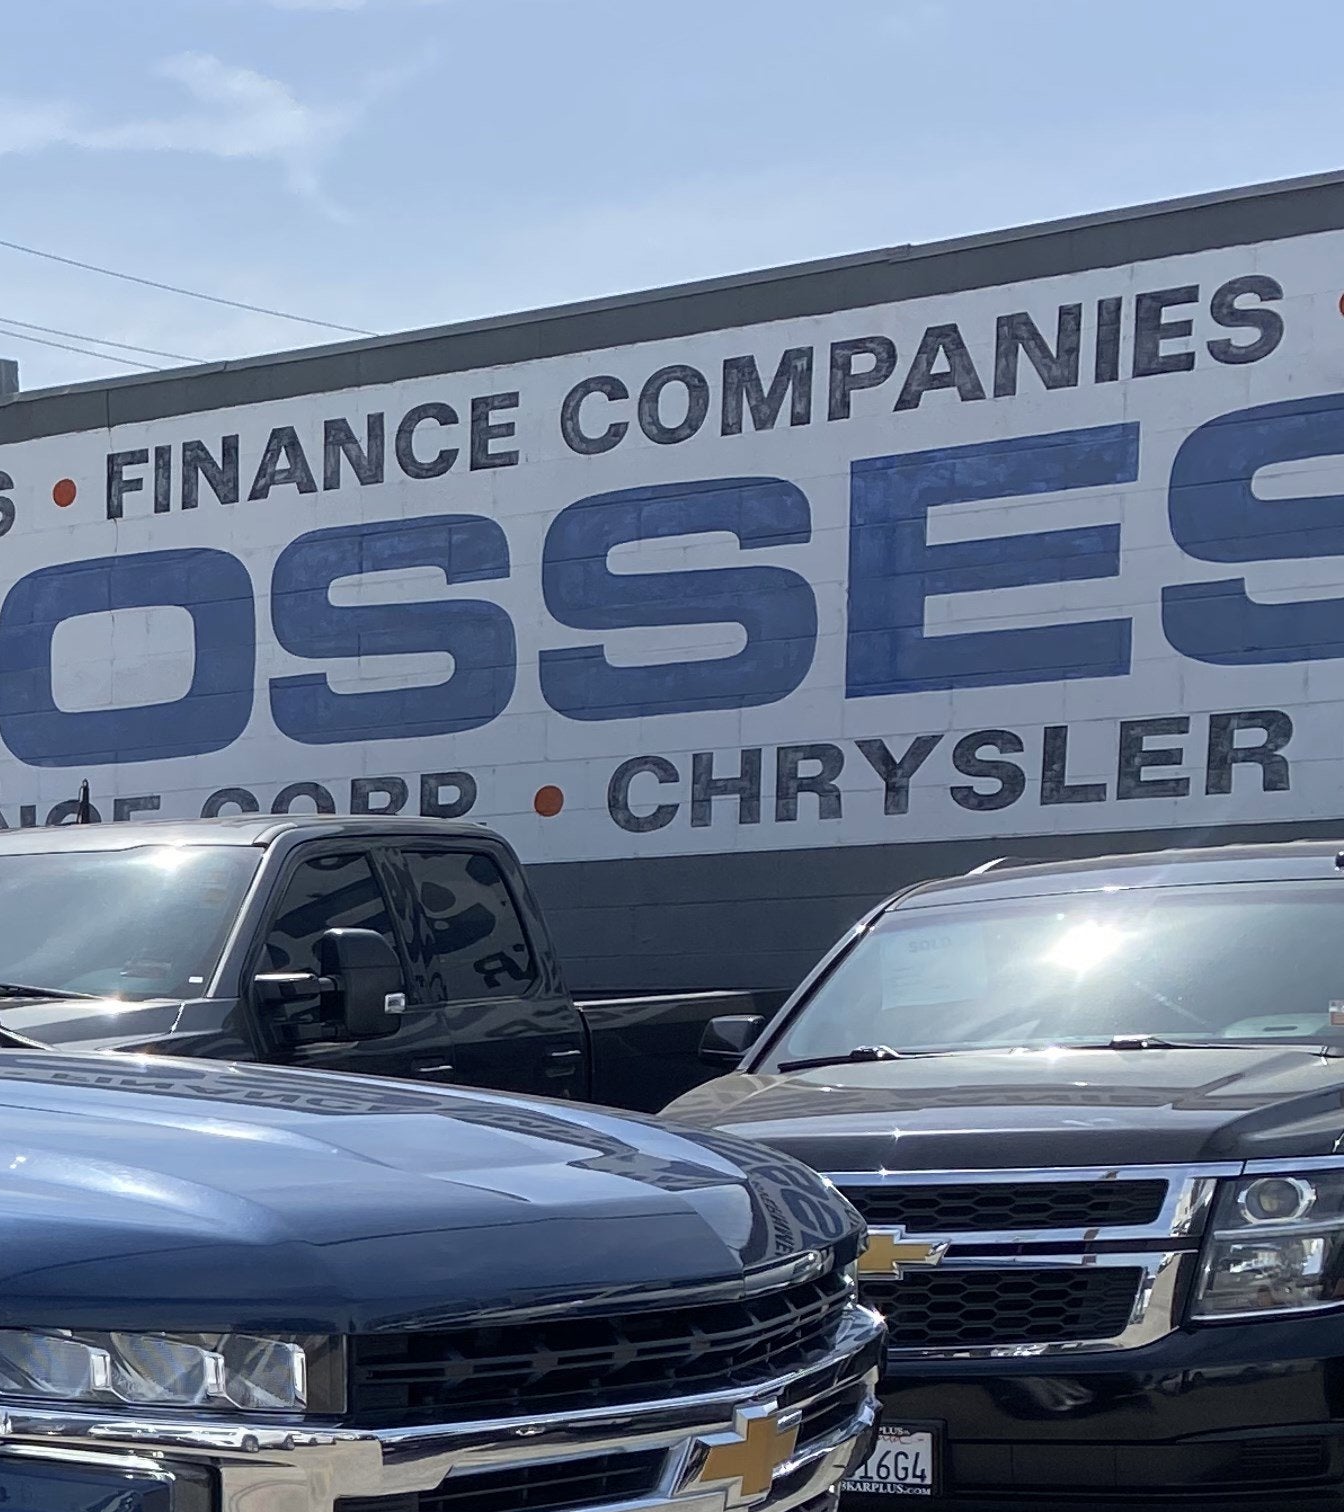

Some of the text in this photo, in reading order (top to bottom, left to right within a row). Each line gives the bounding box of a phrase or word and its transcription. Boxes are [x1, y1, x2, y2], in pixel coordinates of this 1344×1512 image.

[106, 275, 1285, 520] FINANCE COMPANIES
[607, 709, 1295, 833] CHRYSLER
